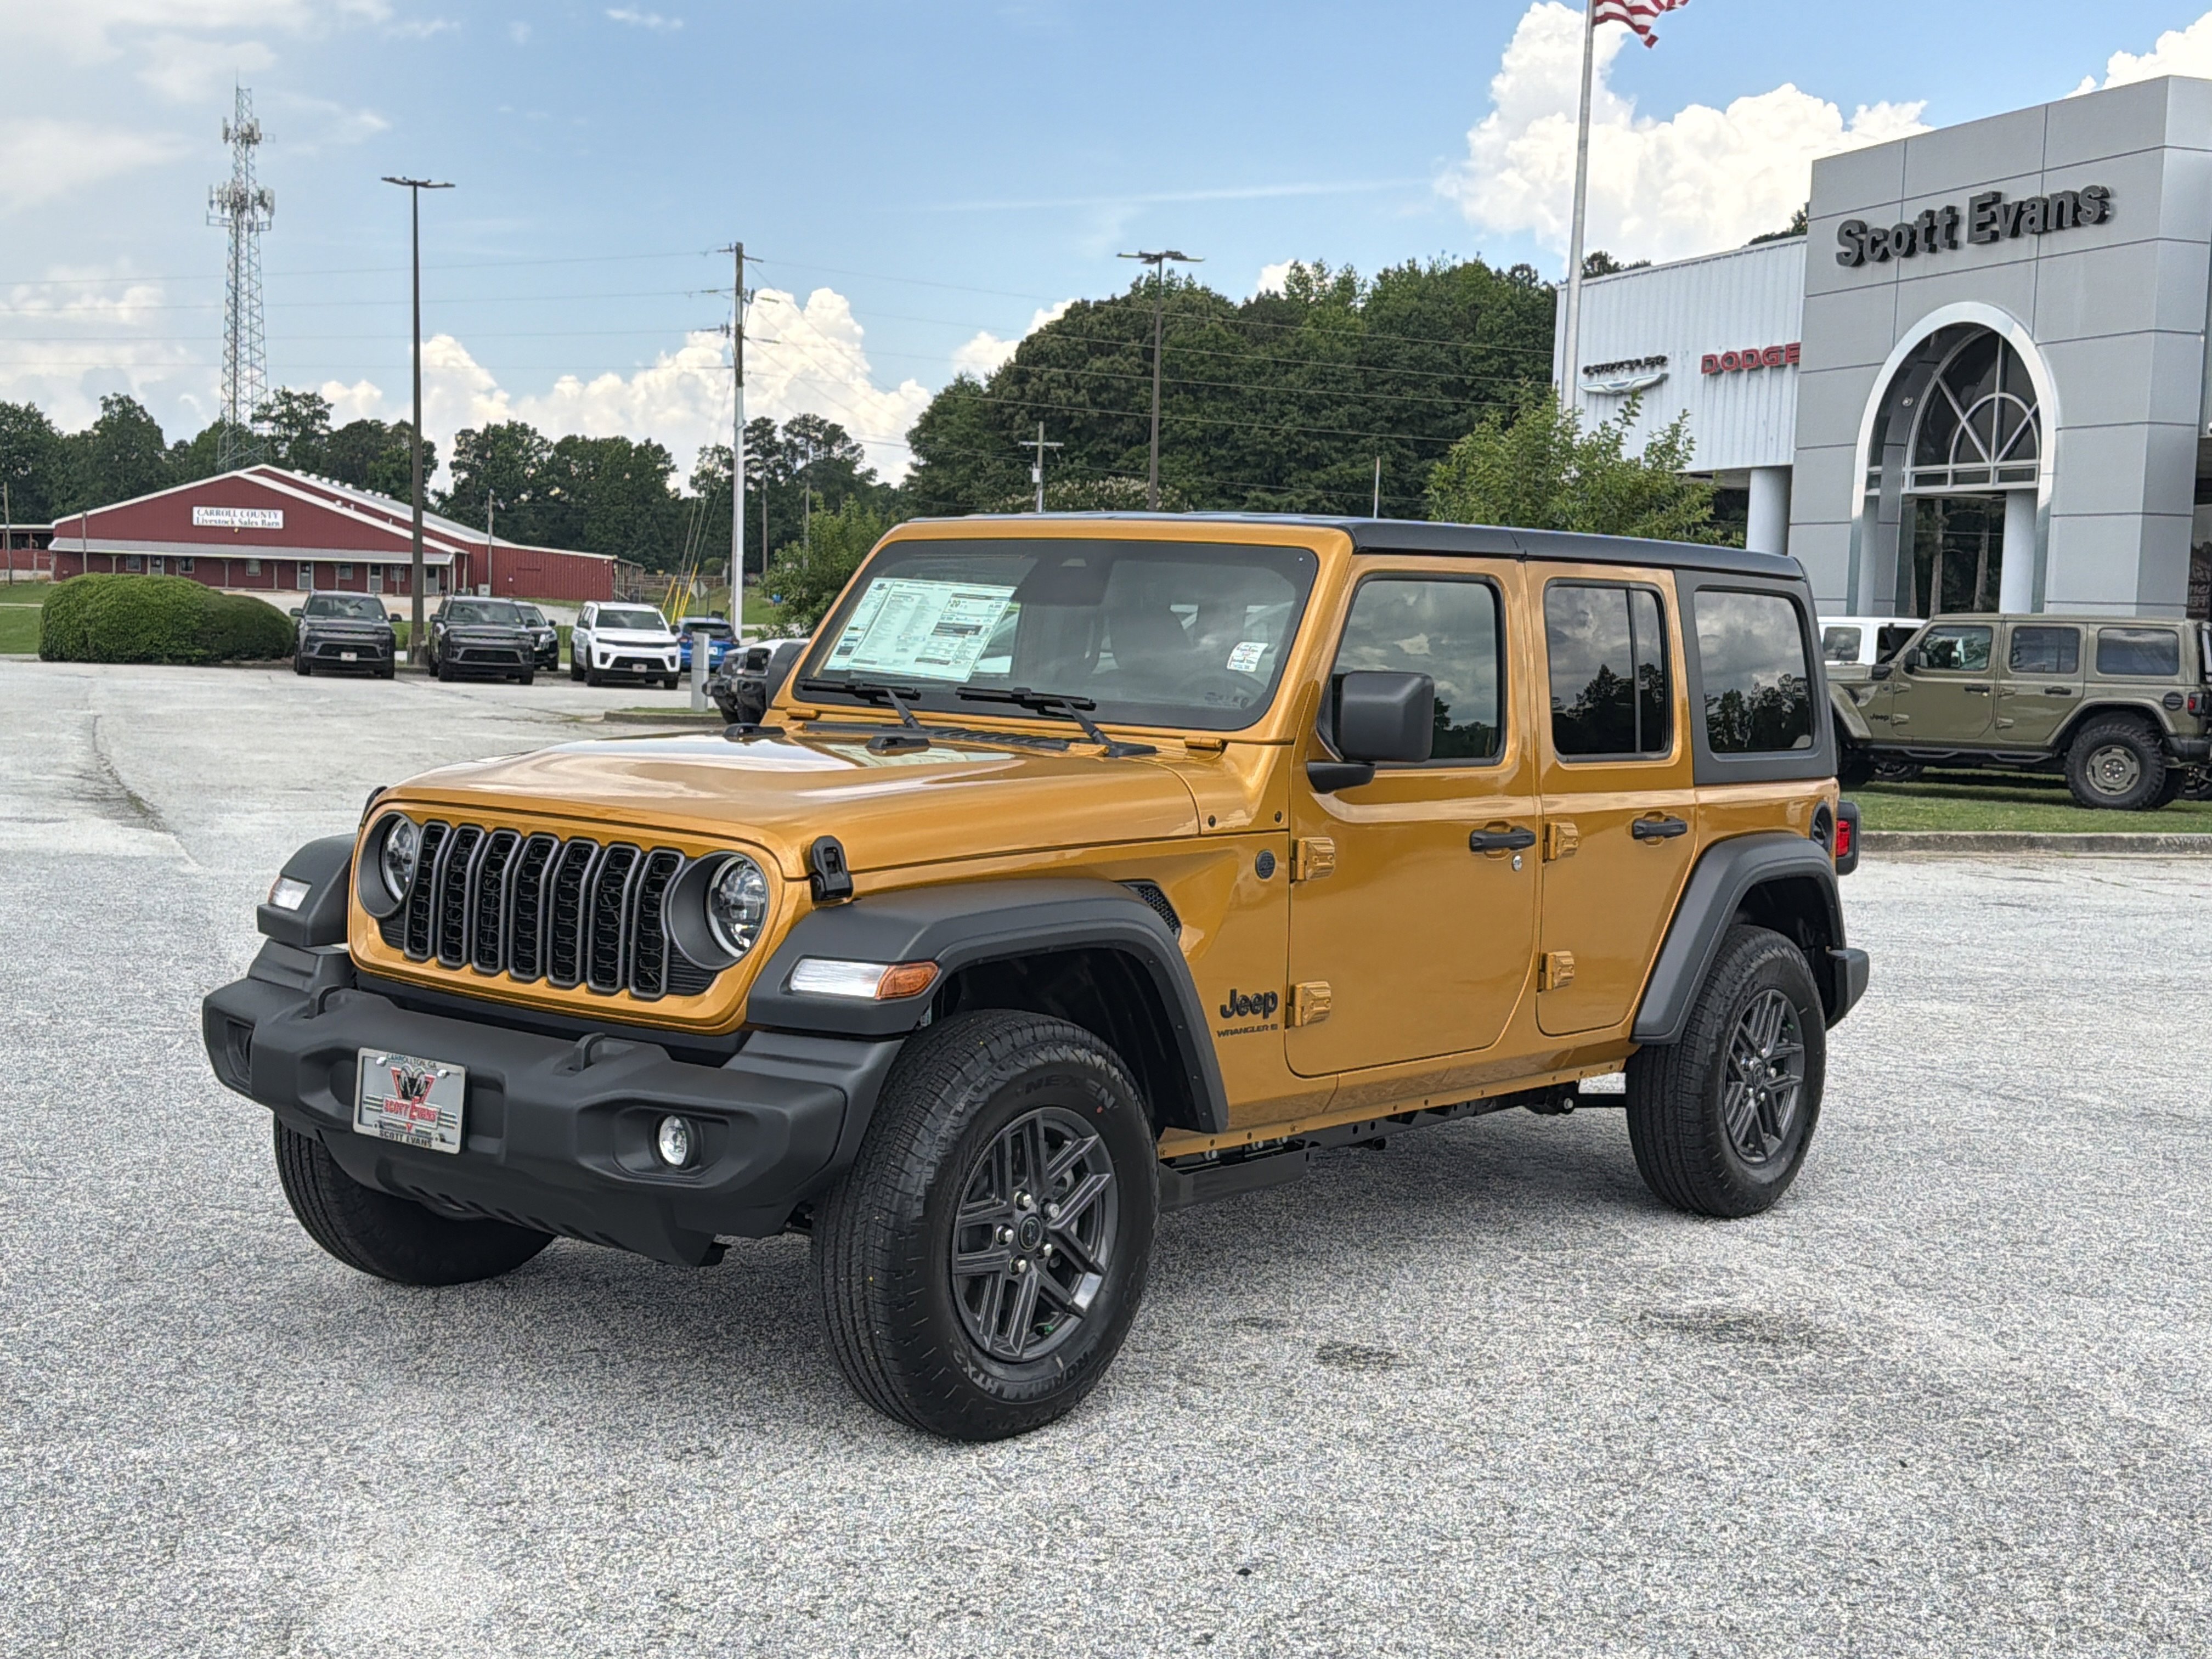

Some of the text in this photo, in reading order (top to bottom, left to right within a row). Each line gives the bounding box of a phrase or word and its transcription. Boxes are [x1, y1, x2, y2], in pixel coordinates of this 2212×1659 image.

[1836, 185, 2110, 267] Scott Evans
[1701, 342, 1801, 374] DODGE
[196, 517, 235, 525] Livestock
[197, 509, 279, 519] CARROLL COUNTY
[1220, 988, 1278, 1020] Jeep
[1216, 1024, 1269, 1038] WRANGLER
[380, 1130, 403, 1142] SCOTT
[407, 1135, 432, 1148] EVANS
